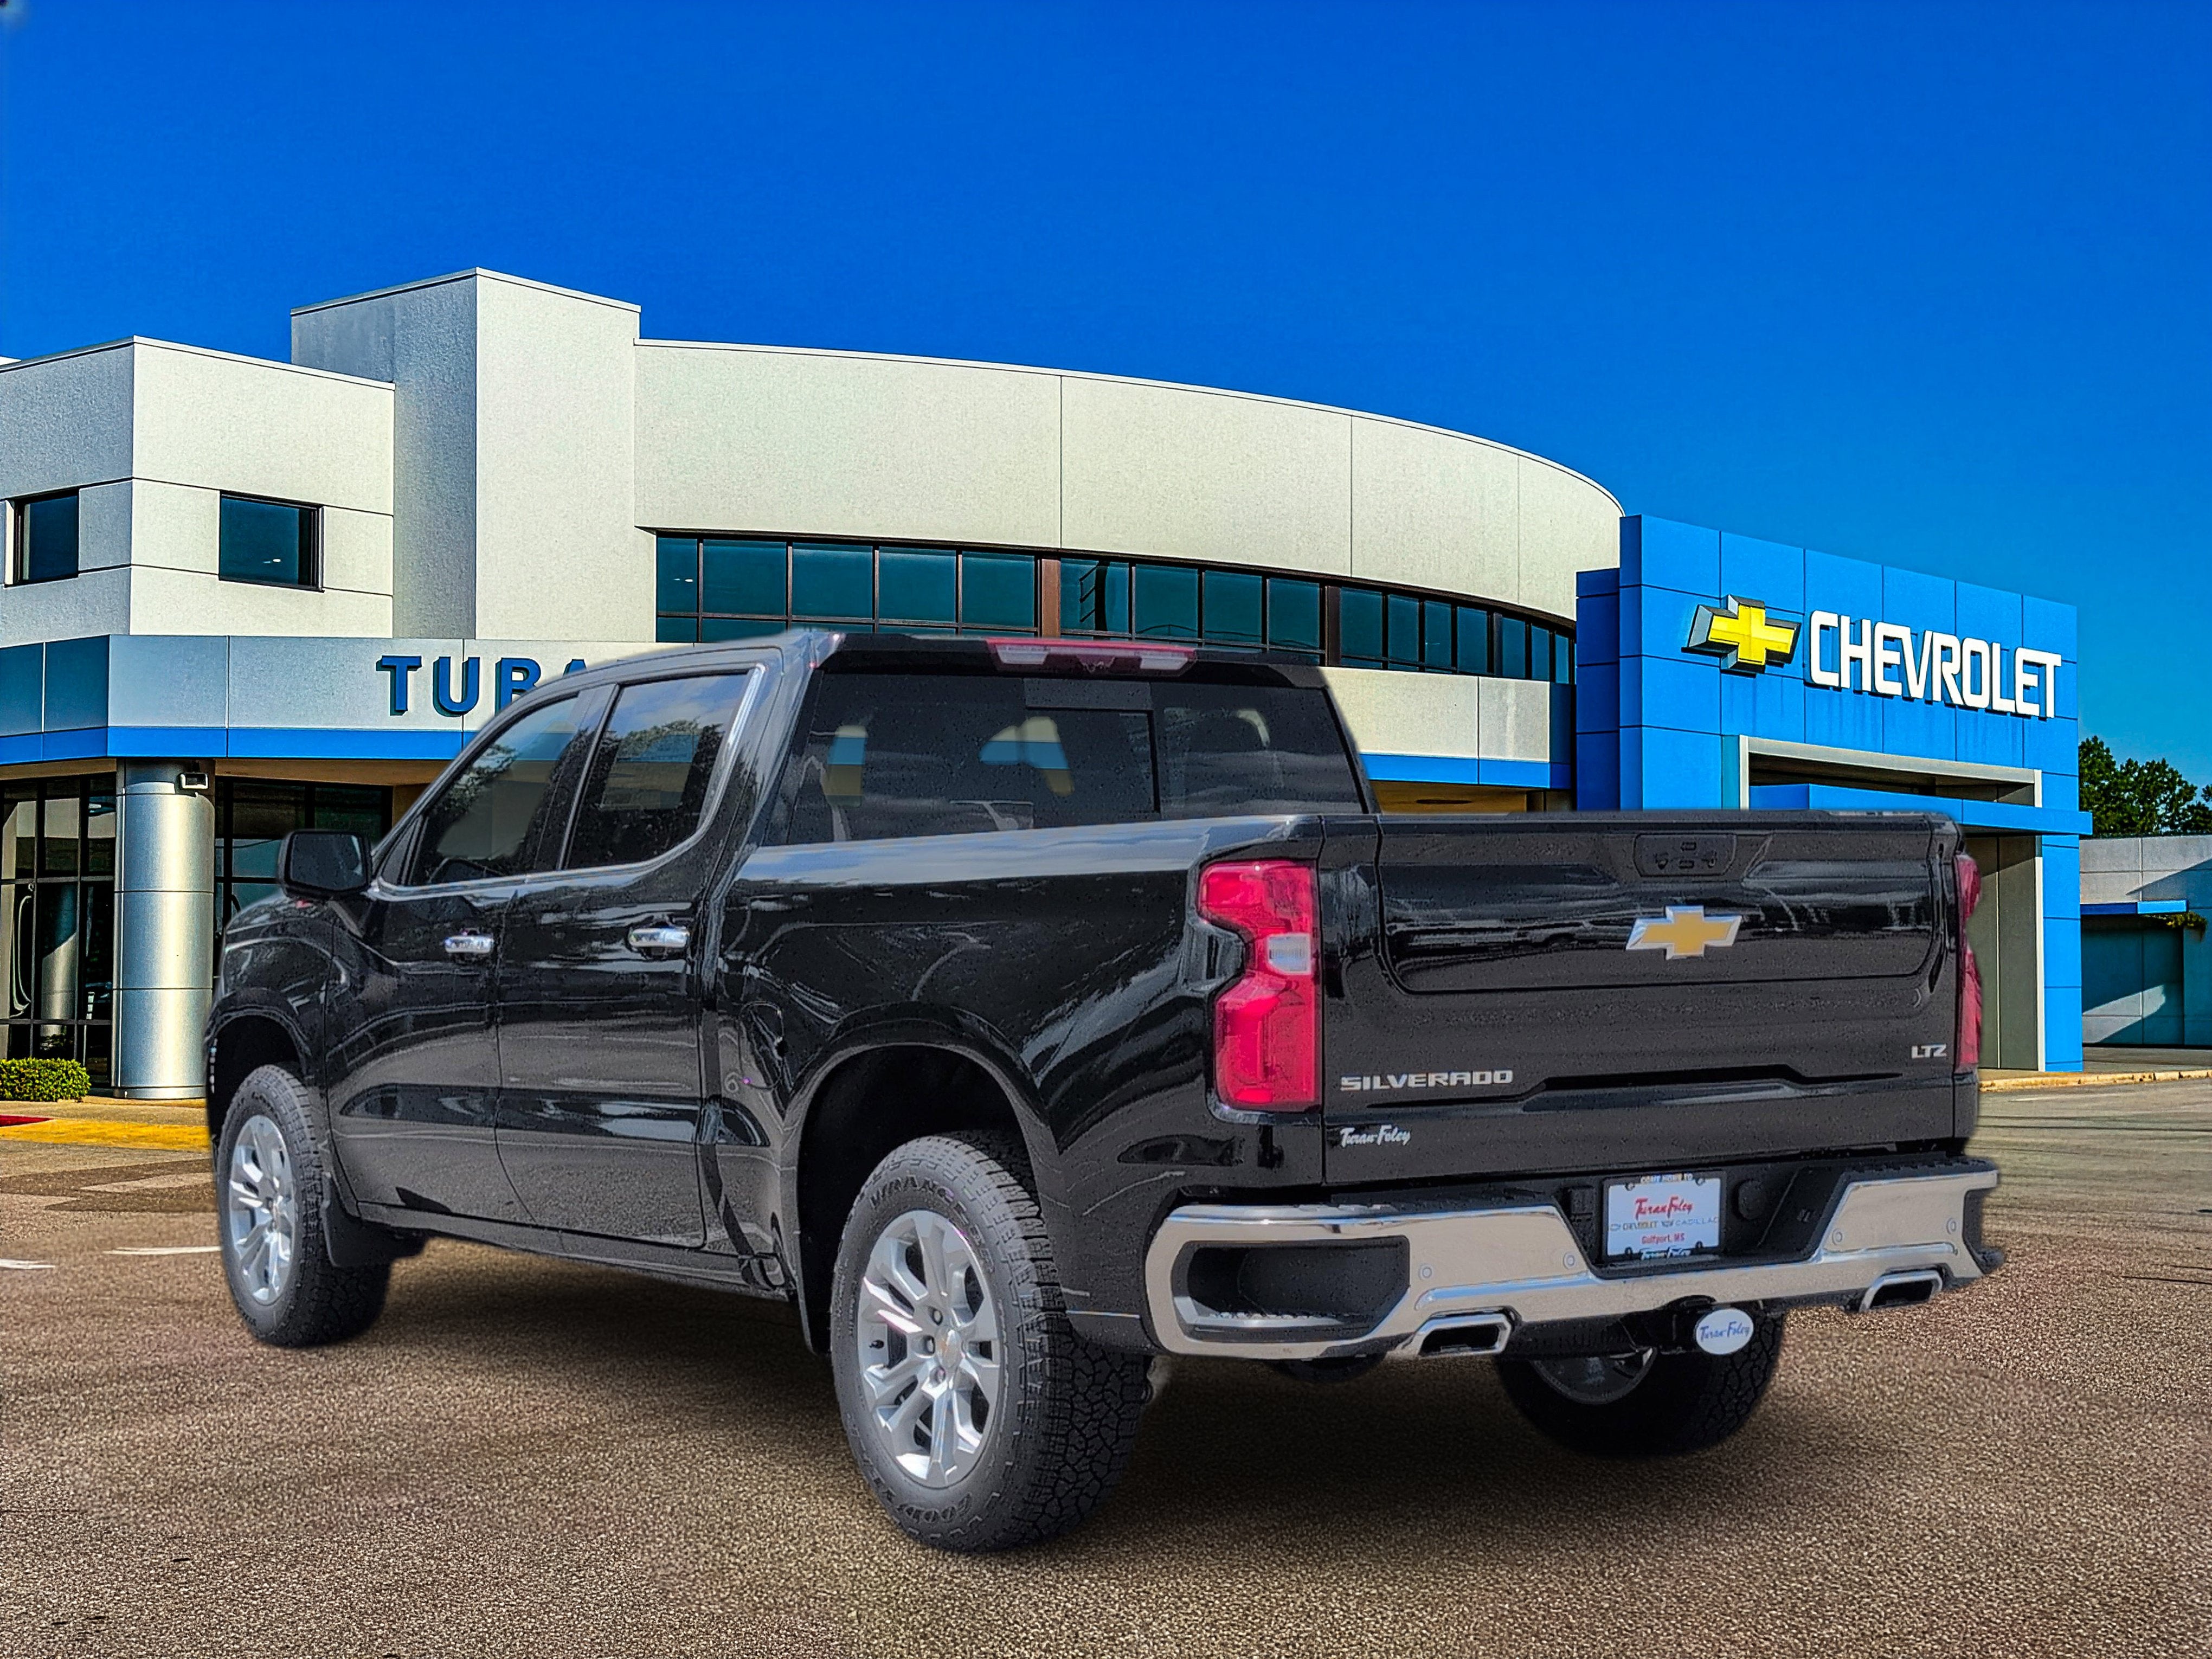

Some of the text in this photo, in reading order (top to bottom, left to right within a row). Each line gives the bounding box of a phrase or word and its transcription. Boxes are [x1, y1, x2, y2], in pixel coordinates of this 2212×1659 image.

[1810, 610, 2061, 718] CHEVROLET
[376, 655, 587, 717] TUR
[1911, 1044, 1947, 1058] LTZ
[1341, 1070, 1513, 1091] SILVERADO
